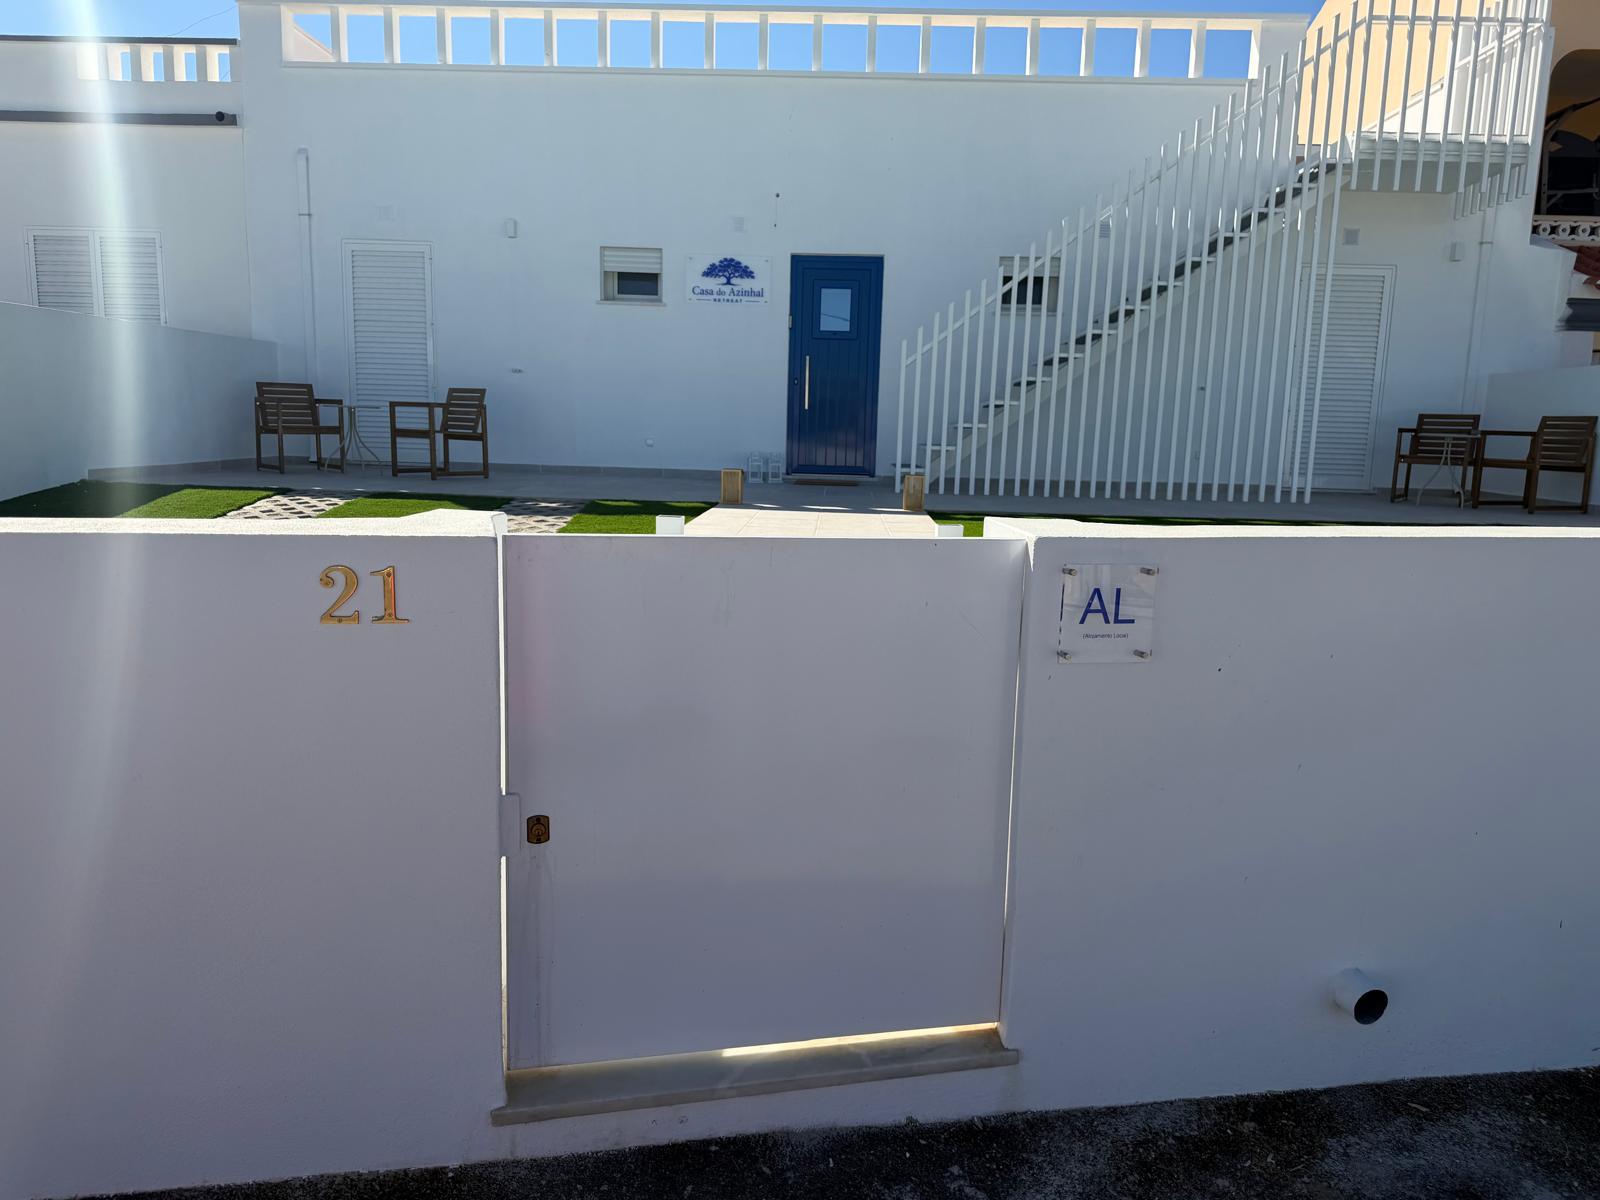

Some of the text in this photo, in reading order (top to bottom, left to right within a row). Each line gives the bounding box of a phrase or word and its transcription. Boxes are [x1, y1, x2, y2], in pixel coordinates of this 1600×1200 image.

[692, 286, 764, 297] Casa do Azinhal
[320, 565, 409, 624] 21
[1079, 588, 1135, 624] AL
